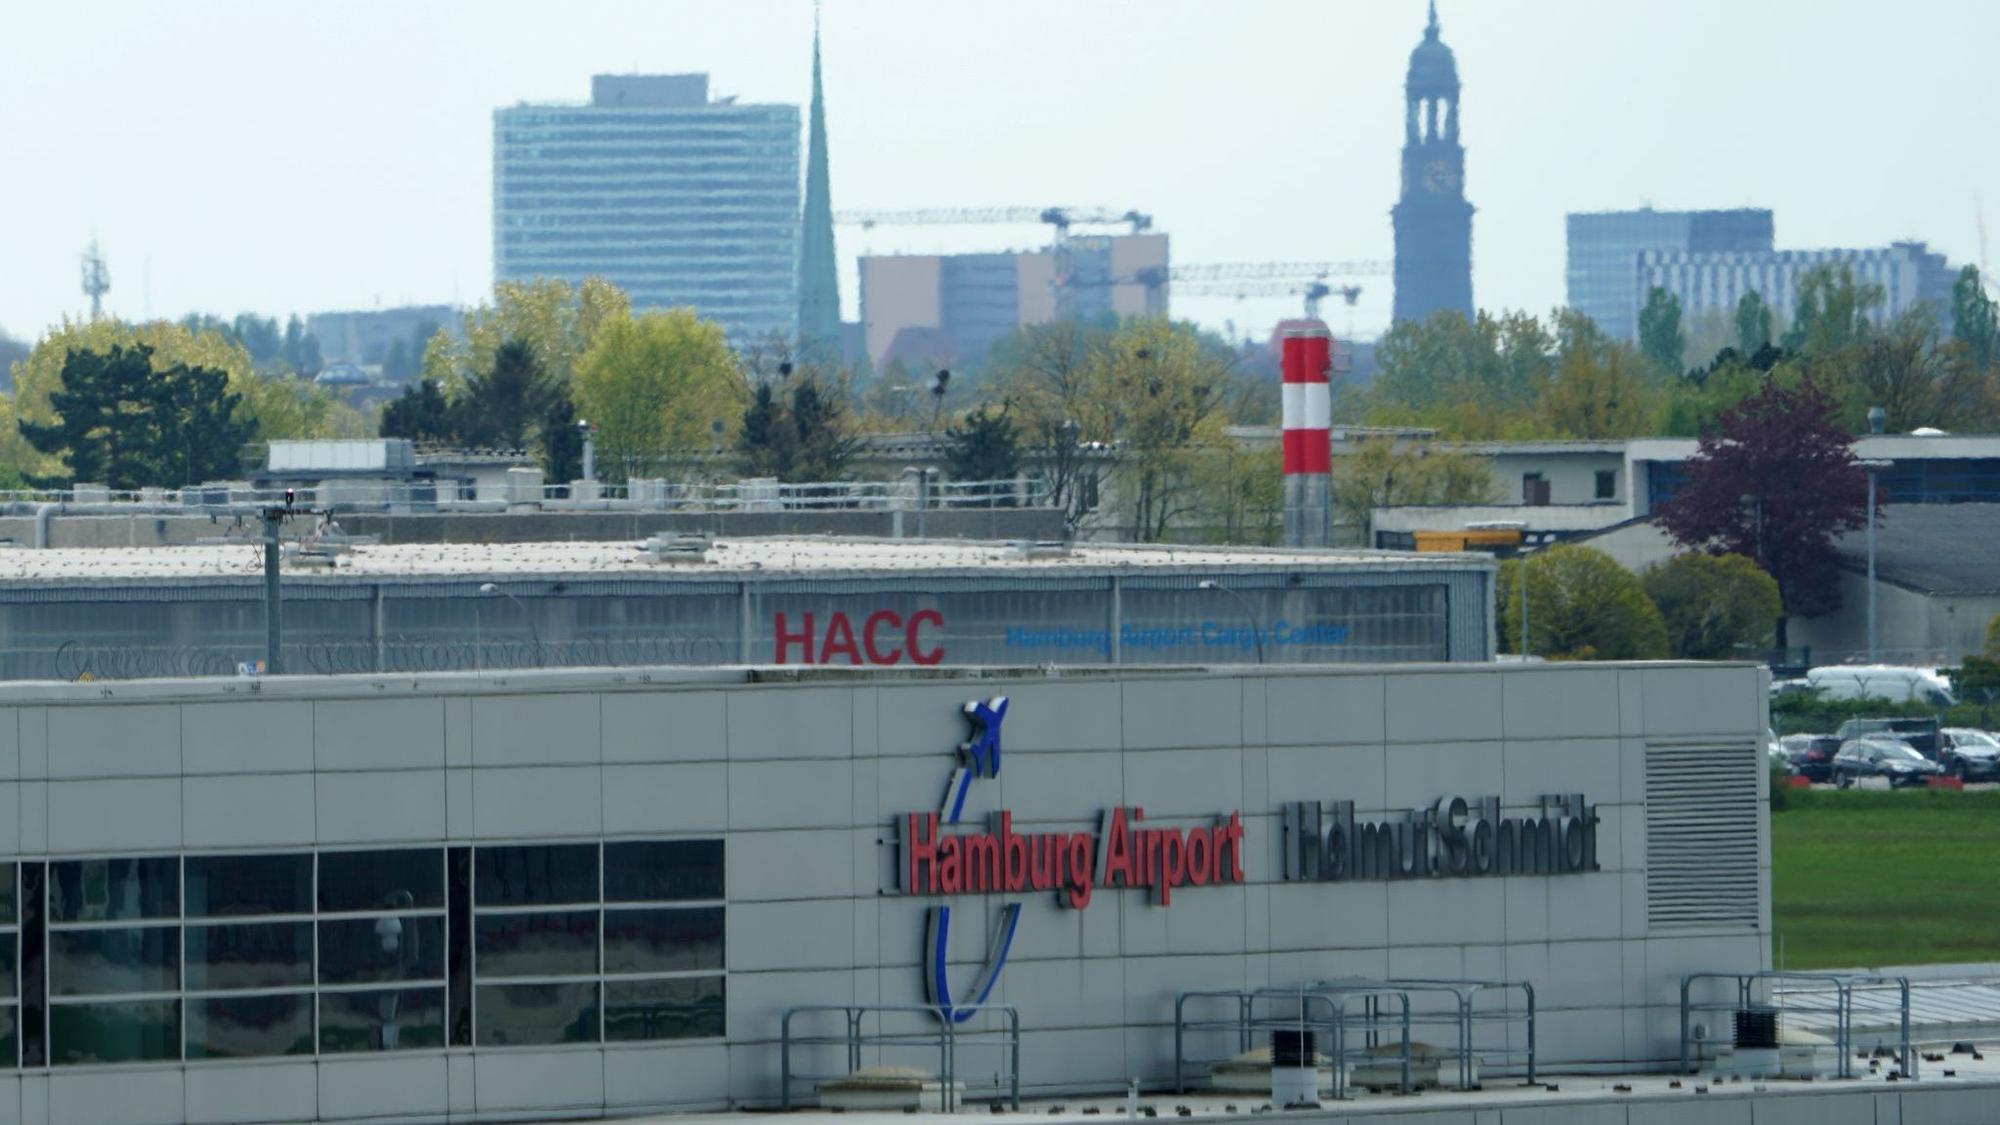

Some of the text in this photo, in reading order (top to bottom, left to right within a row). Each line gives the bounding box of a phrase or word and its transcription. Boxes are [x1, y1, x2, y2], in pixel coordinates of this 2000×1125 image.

[774, 608, 945, 665] HACC
[1007, 620, 1348, 656] Hamburg Airport Cargo Center
[907, 794, 1600, 910] Hamburg Airport Helmut Schmidt
